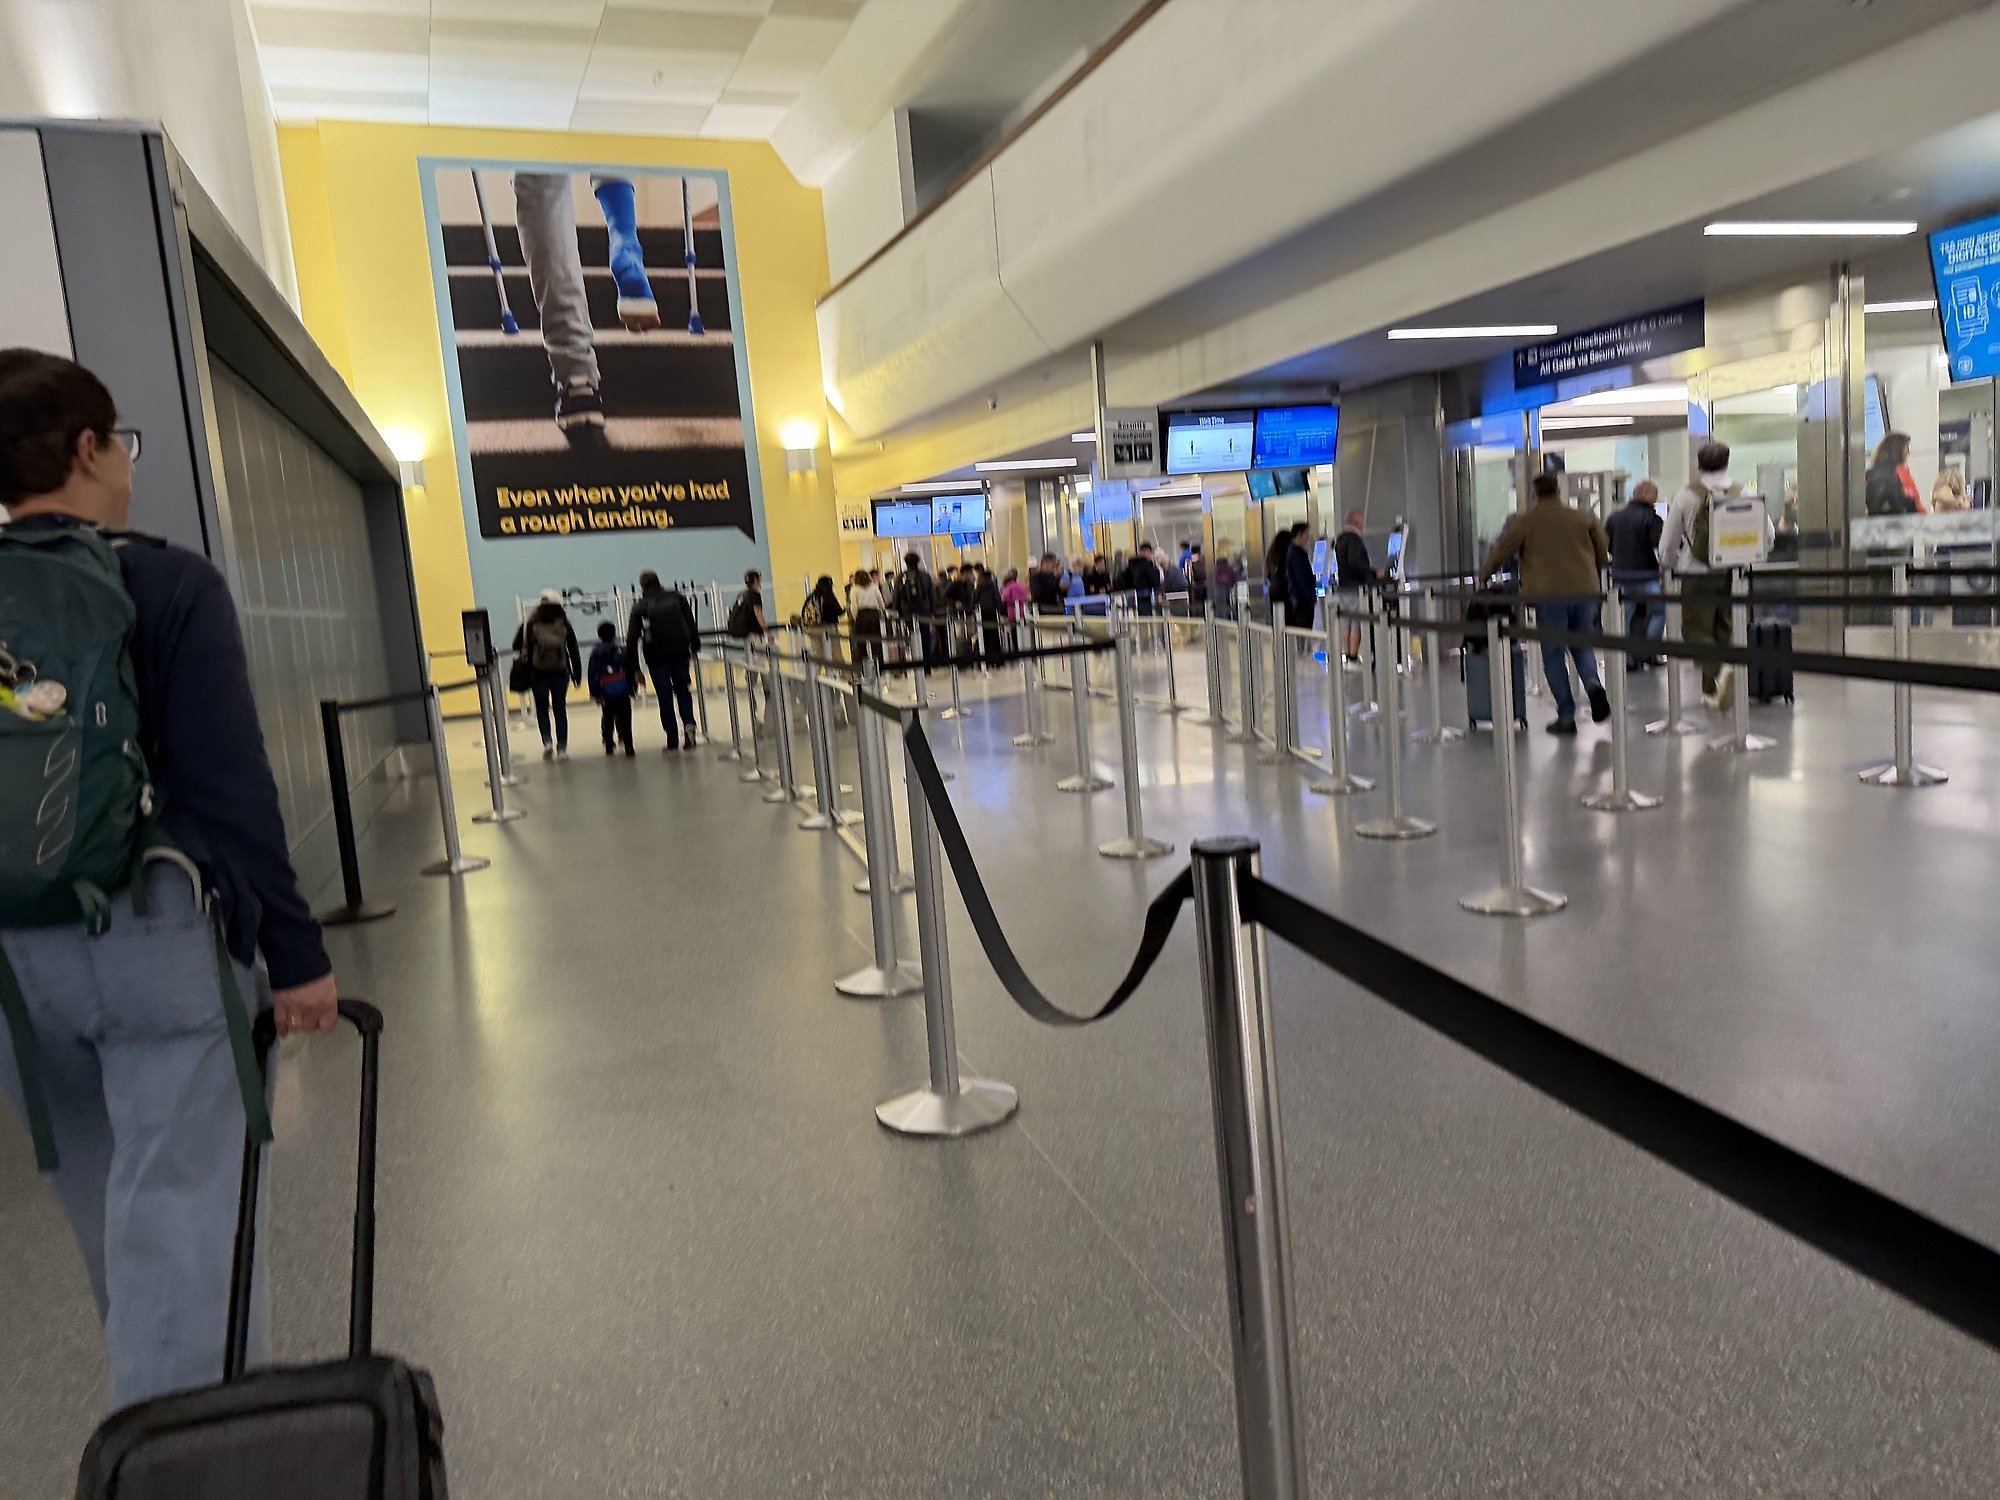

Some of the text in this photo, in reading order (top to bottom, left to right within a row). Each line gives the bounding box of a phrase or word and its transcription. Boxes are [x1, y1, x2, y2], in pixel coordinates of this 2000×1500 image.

[1963, 303, 1975, 320] ID
[1539, 340, 1572, 361] Security
[1573, 326, 1622, 352] Checkpoint
[1540, 338, 1652, 377] All Gates via Secure Walkway
[496, 479, 730, 508] Even when you've had
[500, 506, 674, 534] a rough landing.
